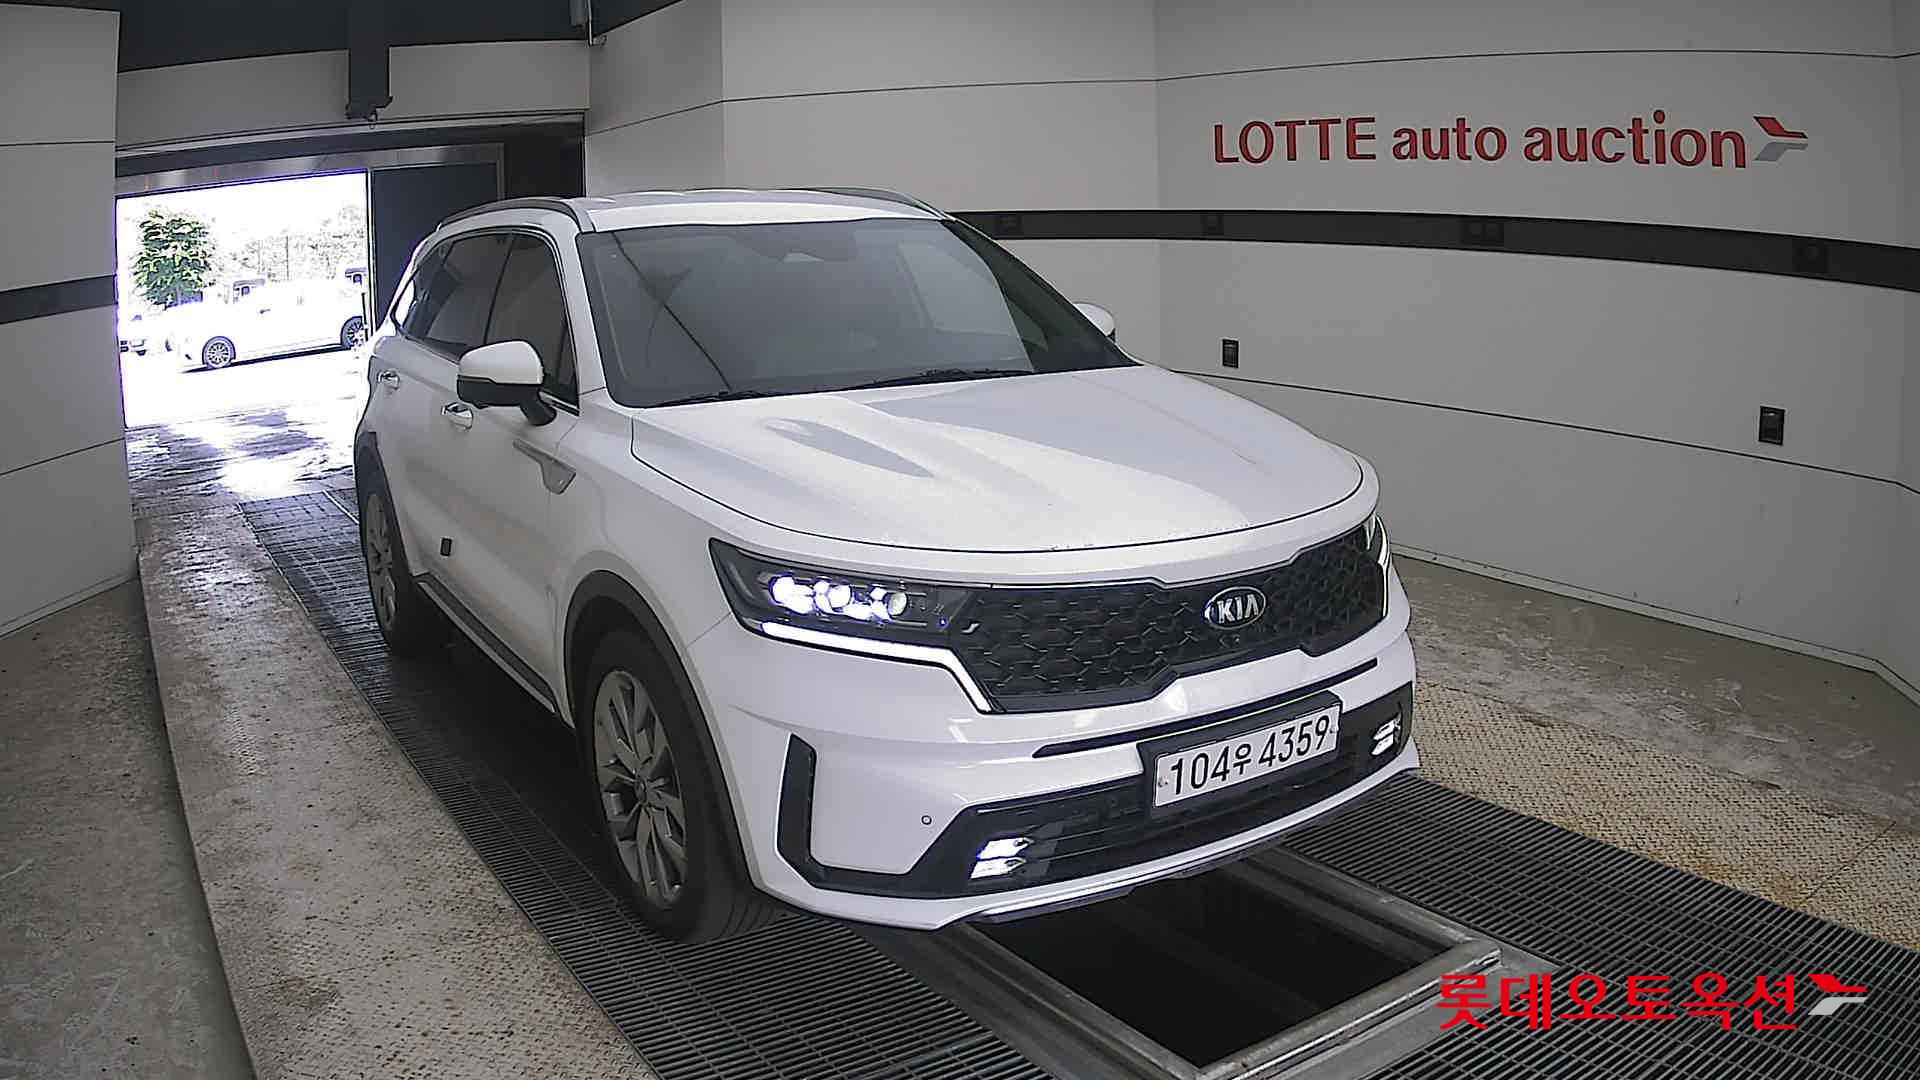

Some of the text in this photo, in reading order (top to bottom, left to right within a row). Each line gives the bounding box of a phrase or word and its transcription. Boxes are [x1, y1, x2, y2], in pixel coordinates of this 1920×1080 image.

[1213, 110, 1747, 168] LOTTE auto auction
[1216, 594, 1259, 624] KIA
